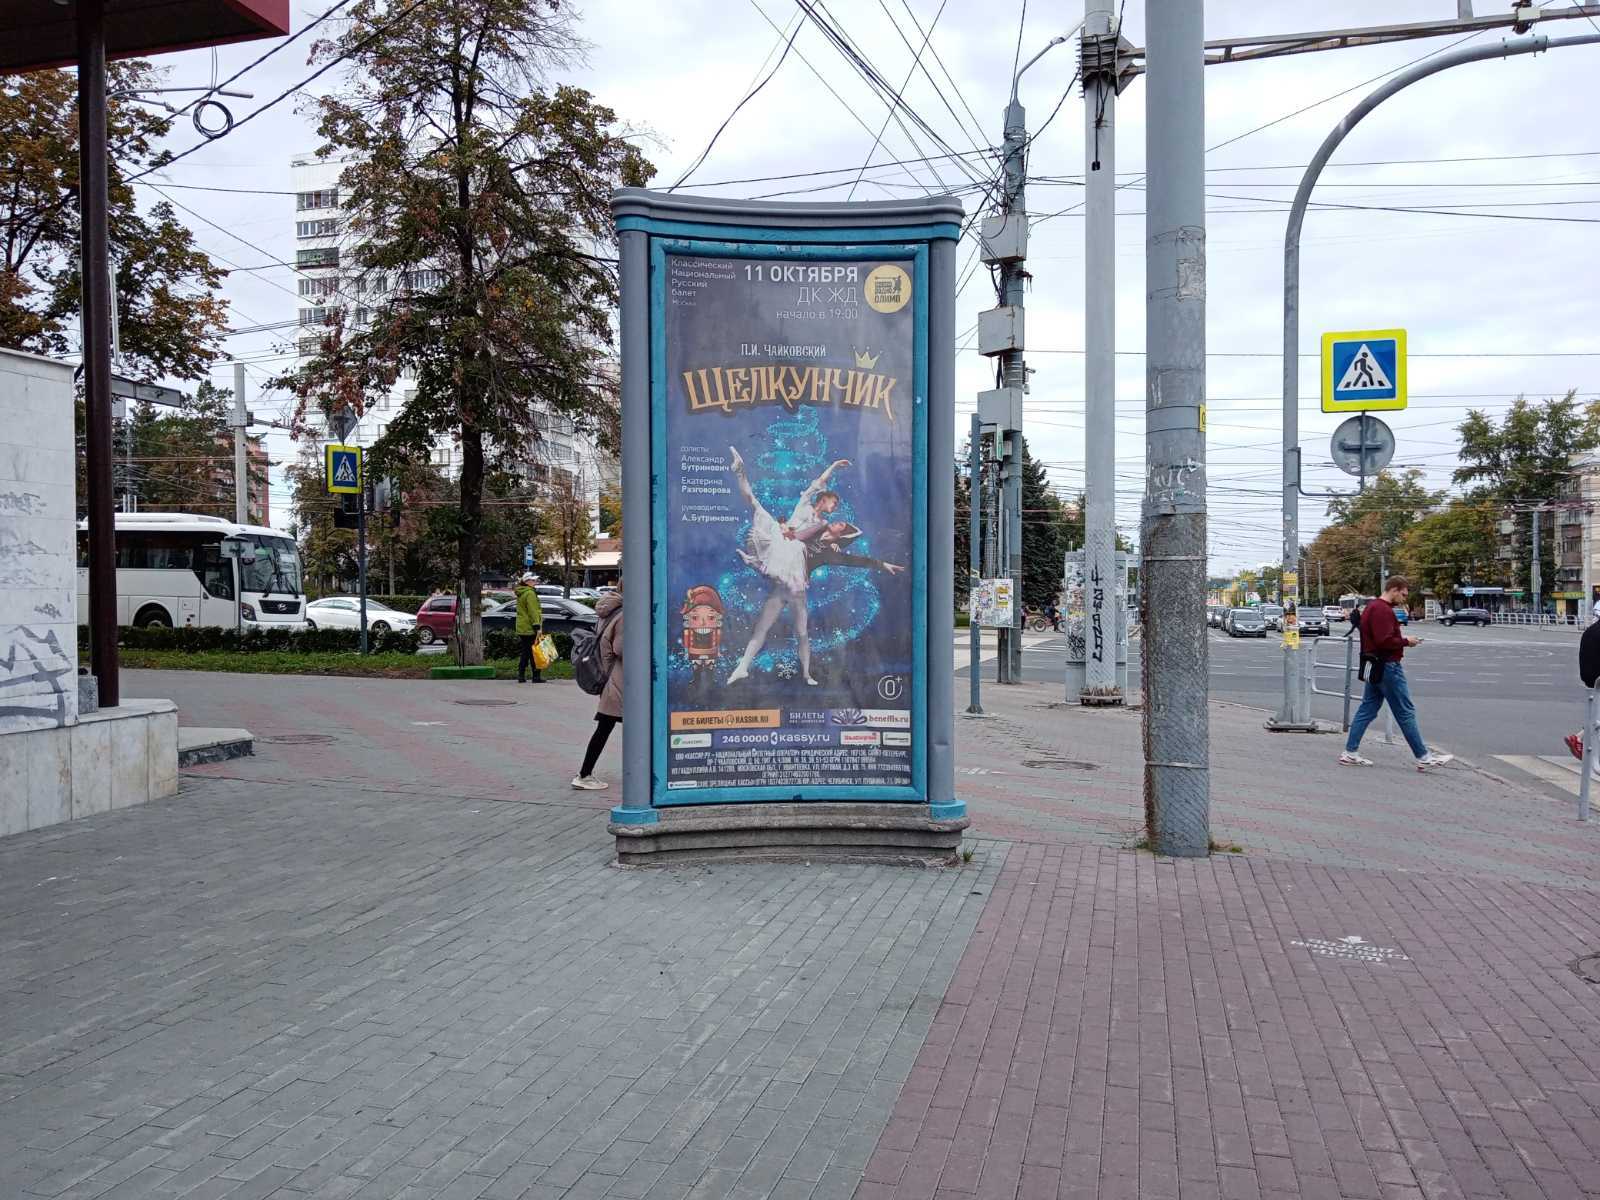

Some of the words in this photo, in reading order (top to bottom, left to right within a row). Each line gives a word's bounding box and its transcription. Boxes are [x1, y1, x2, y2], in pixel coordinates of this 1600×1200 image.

[671, 258, 733, 269] Классический
[744, 265, 763, 281] 11
[770, 265, 858, 282] ОКТЯБРЯ
[671, 278, 708, 288] Русский
[797, 286, 822, 306] ДК
[827, 287, 858, 307] ЖД
[776, 311, 816, 320] начало
[830, 308, 858, 320] 19:00
[740, 343, 761, 356] П.И.
[763, 343, 827, 359] ЧАЙКОВСКИЙ
[682, 366, 897, 422] ЩЕЛКУНЧИК
[681, 455, 725, 464] Александр
[681, 477, 723, 486] Екатерина
[722, 735, 740, 743] 246
[742, 735, 769, 743] 0000
[779, 732, 831, 745] kassy.ru
